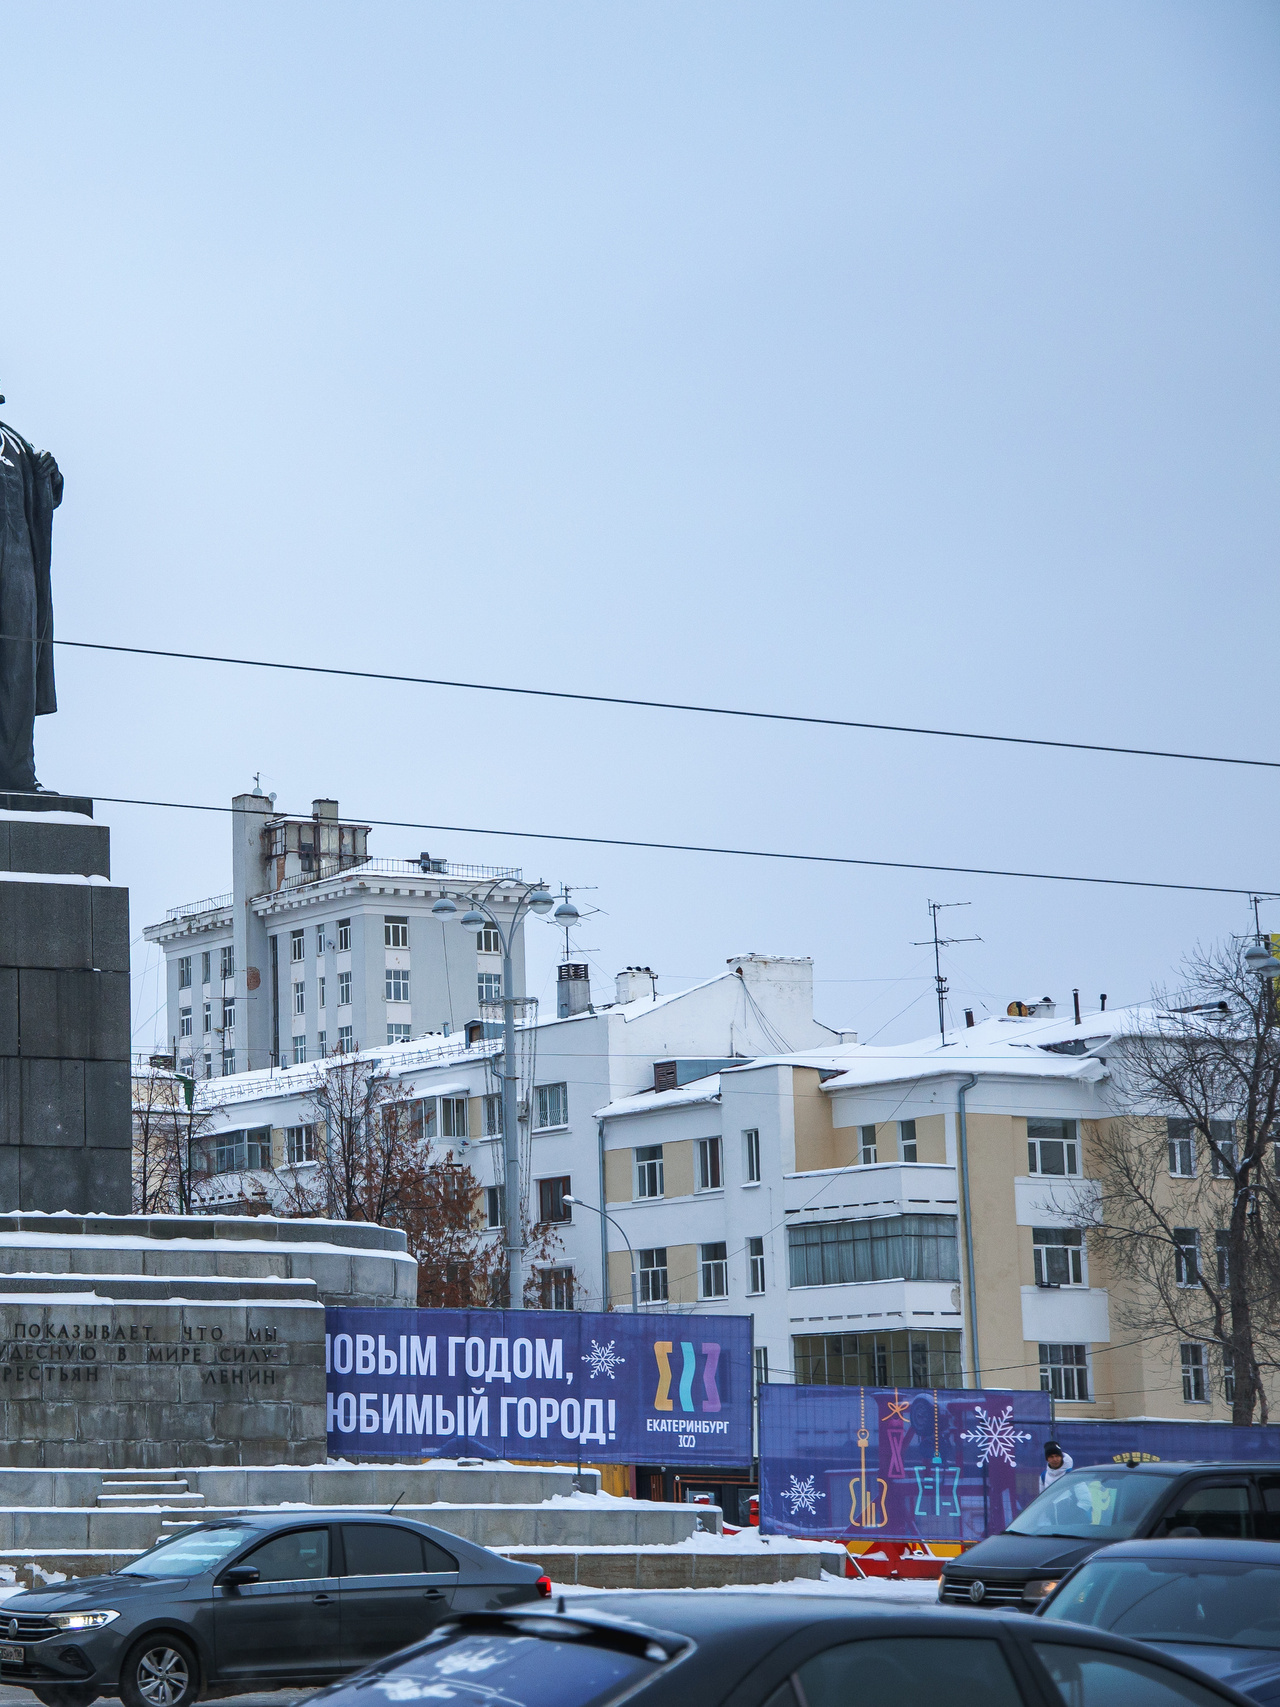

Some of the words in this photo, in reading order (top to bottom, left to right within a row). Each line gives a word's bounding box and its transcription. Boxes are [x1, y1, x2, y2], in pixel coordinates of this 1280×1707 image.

[183, 1325, 223, 1341] ЧТО
[248, 1326, 277, 1342] МЫ
[116, 1346, 127, 1362] В
[148, 1347, 201, 1363] МИРЕ
[325, 1333, 437, 1376] ОВЫМ
[448, 1336, 574, 1385] ГОДОМ,
[204, 1369, 276, 1385] ЛЕНИН
[500, 1396, 616, 1445] ГОРОД!
[646, 1418, 730, 1434] ЕКАТЕРИНБУРГ
